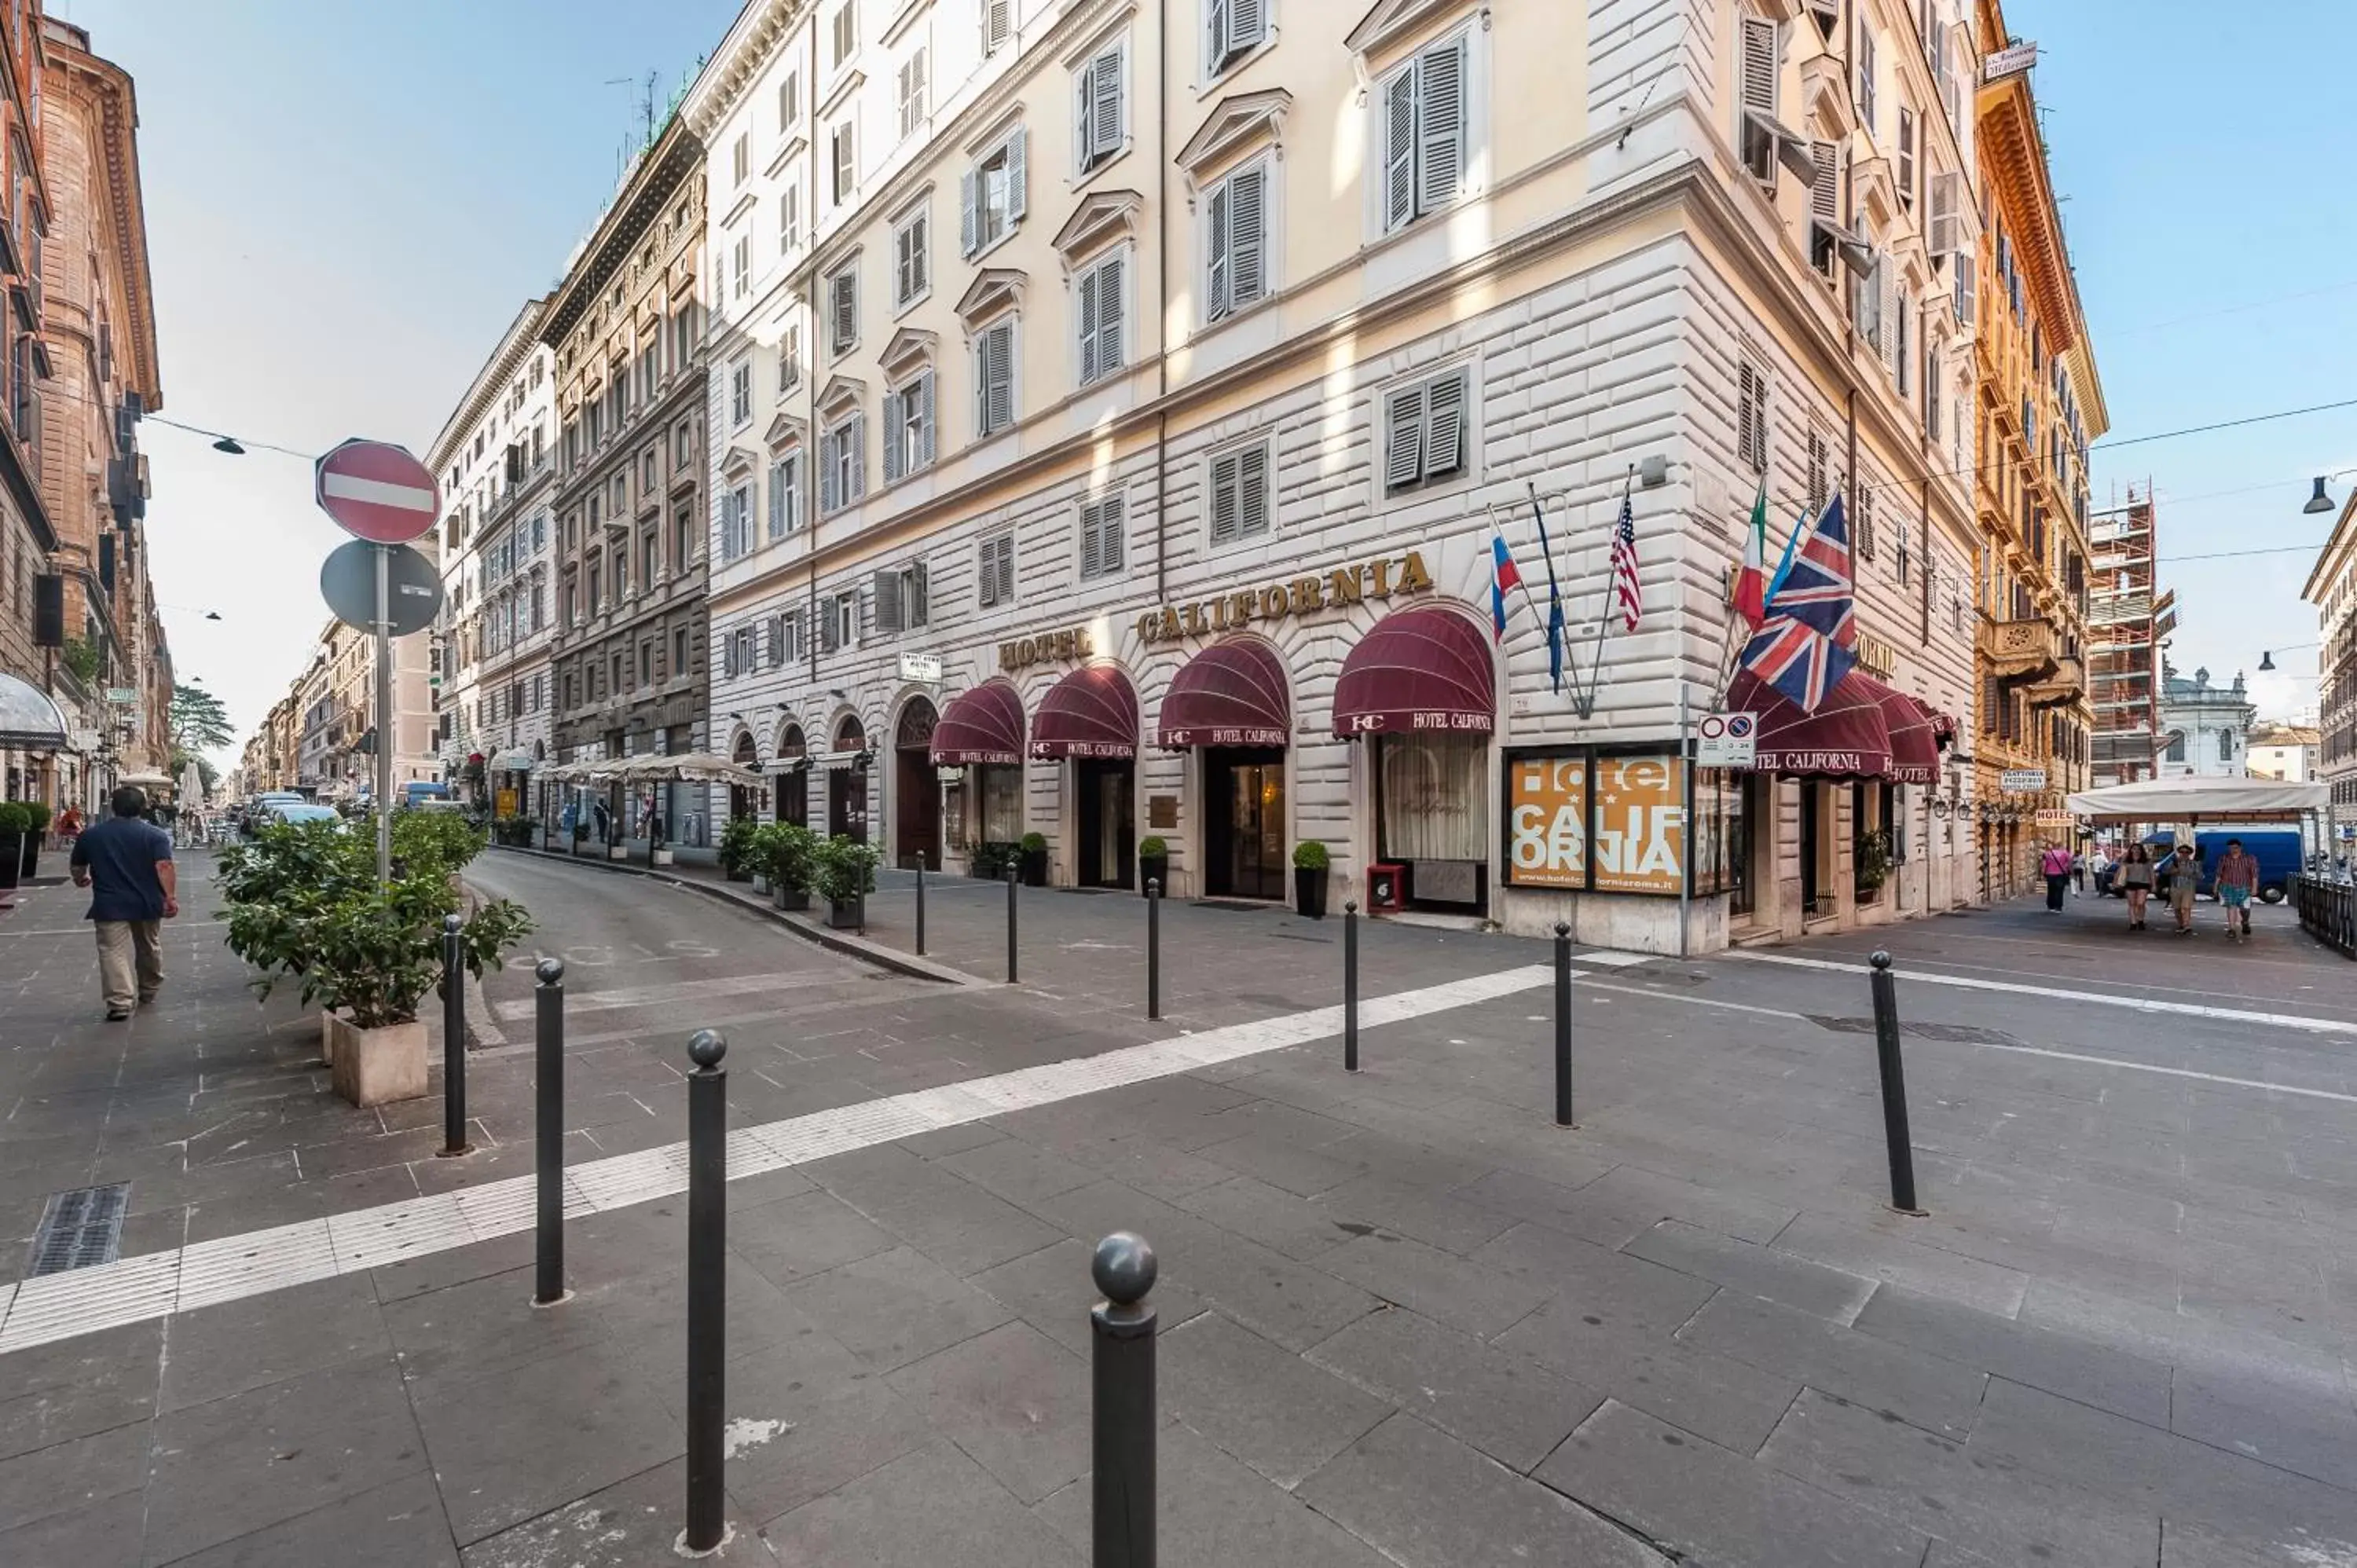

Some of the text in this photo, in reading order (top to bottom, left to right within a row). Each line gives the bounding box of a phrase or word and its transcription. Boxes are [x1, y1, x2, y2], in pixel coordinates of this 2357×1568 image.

[999, 551, 1433, 671] HOTEL CALIFORNIA
[1413, 713, 1448, 729] HOTEL
[1212, 730, 1242, 742] HOTEL
[1245, 731, 1285, 744] CALIFORNIA
[1068, 742, 1092, 755] HOTEL
[959, 752, 982, 762] HOTEL
[1743, 753, 1781, 770] TEL
[1785, 754, 1860, 771] CALIFORNIA
[2037, 811, 2073, 819] HOTEL
